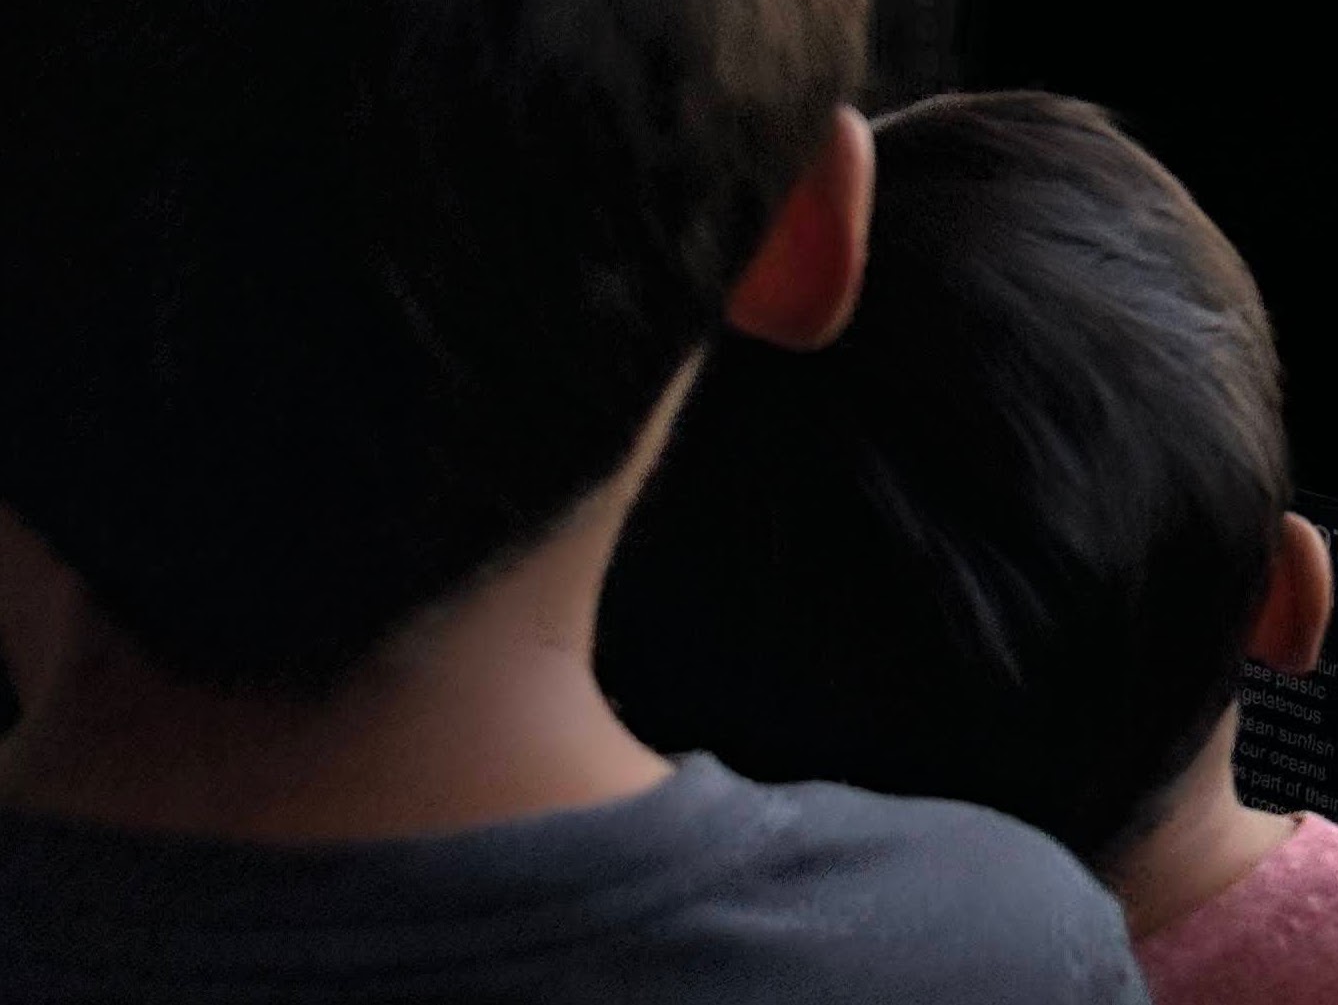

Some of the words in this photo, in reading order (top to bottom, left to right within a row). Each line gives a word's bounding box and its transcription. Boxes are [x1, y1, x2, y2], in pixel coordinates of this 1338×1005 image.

[1276, 673, 1327, 700] plastic
[1241, 687, 1323, 725] gelatinous
[1278, 726, 1335, 759] sunfish
[1269, 750, 1329, 781] oceans
[1251, 770, 1282, 793] part
[1286, 780, 1301, 798] of
